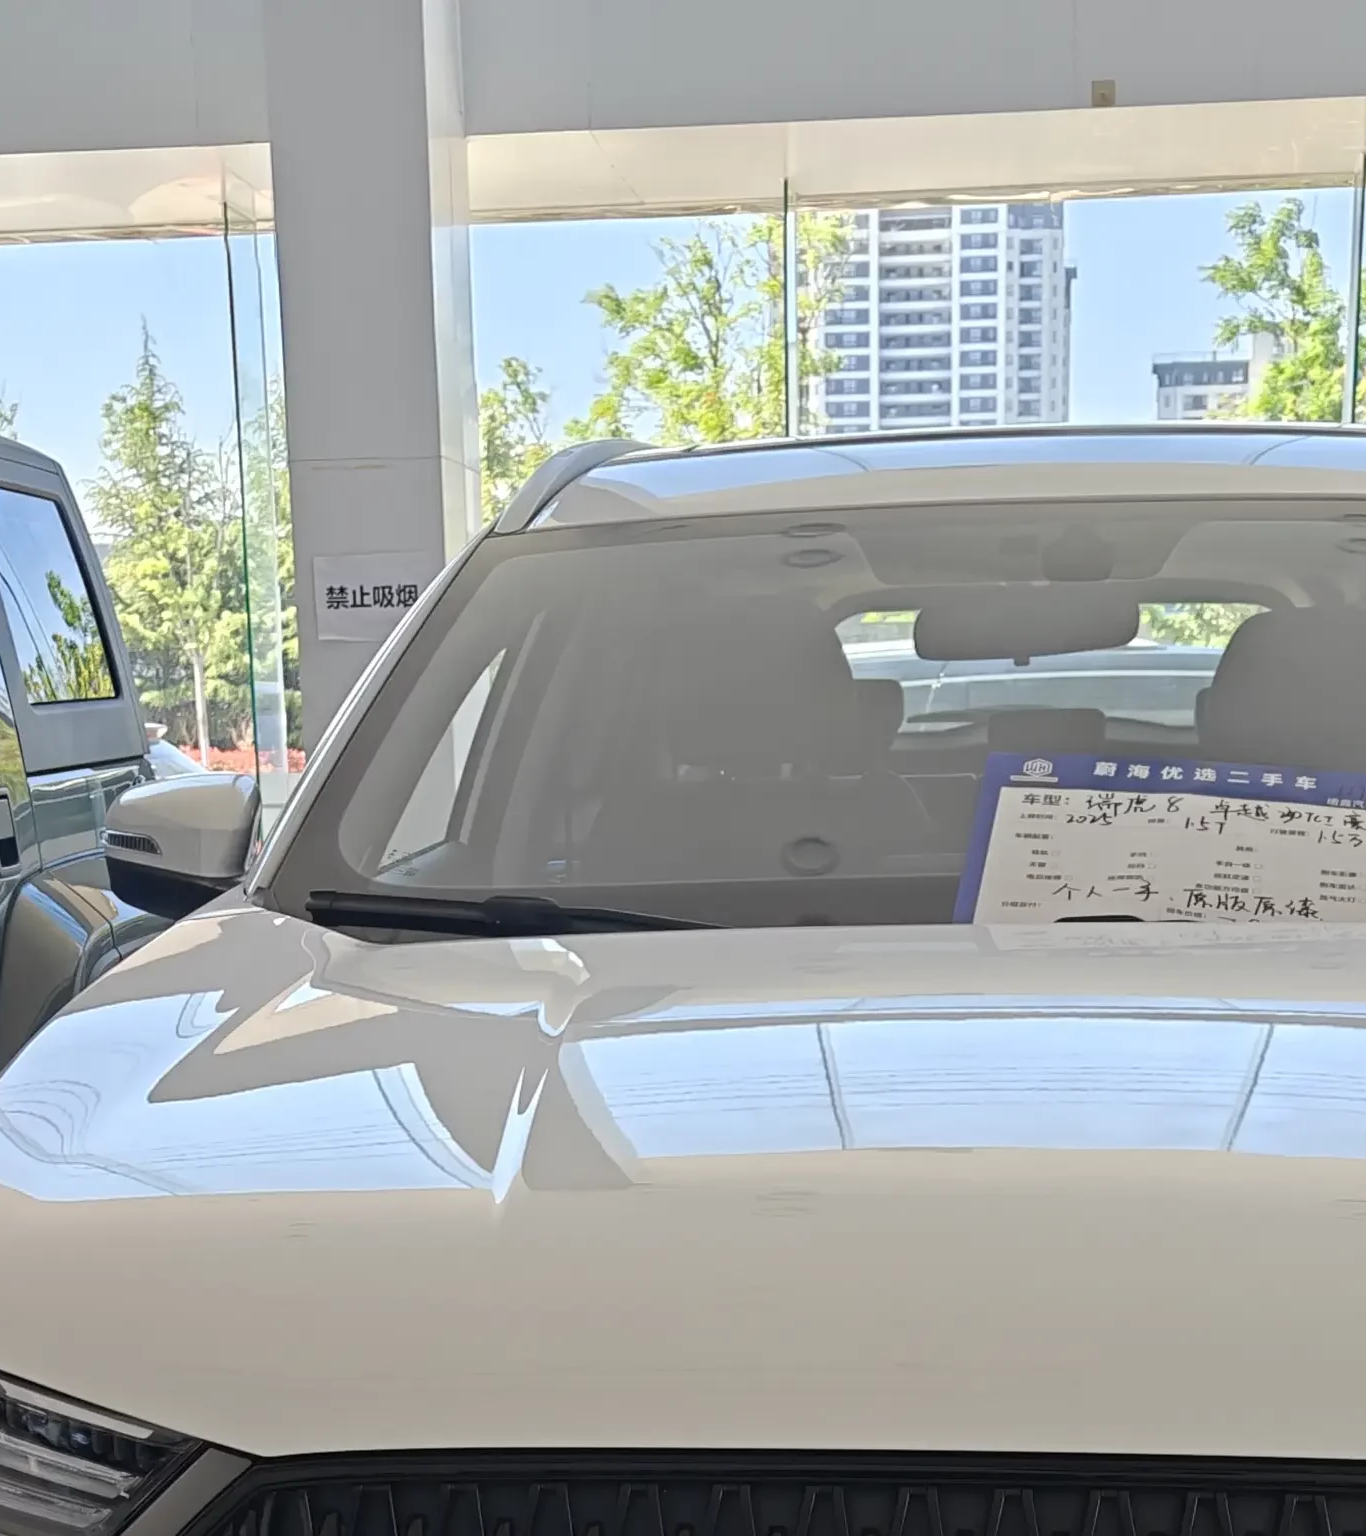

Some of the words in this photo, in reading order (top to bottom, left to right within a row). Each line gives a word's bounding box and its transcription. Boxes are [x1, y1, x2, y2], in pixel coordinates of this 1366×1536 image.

[325, 584, 418, 610] 禁止吸烟
[1092, 760, 1317, 791] 蔚海优选二手车
[1065, 812, 1114, 826] 2025
[1184, 816, 1227, 834] 1.5T
